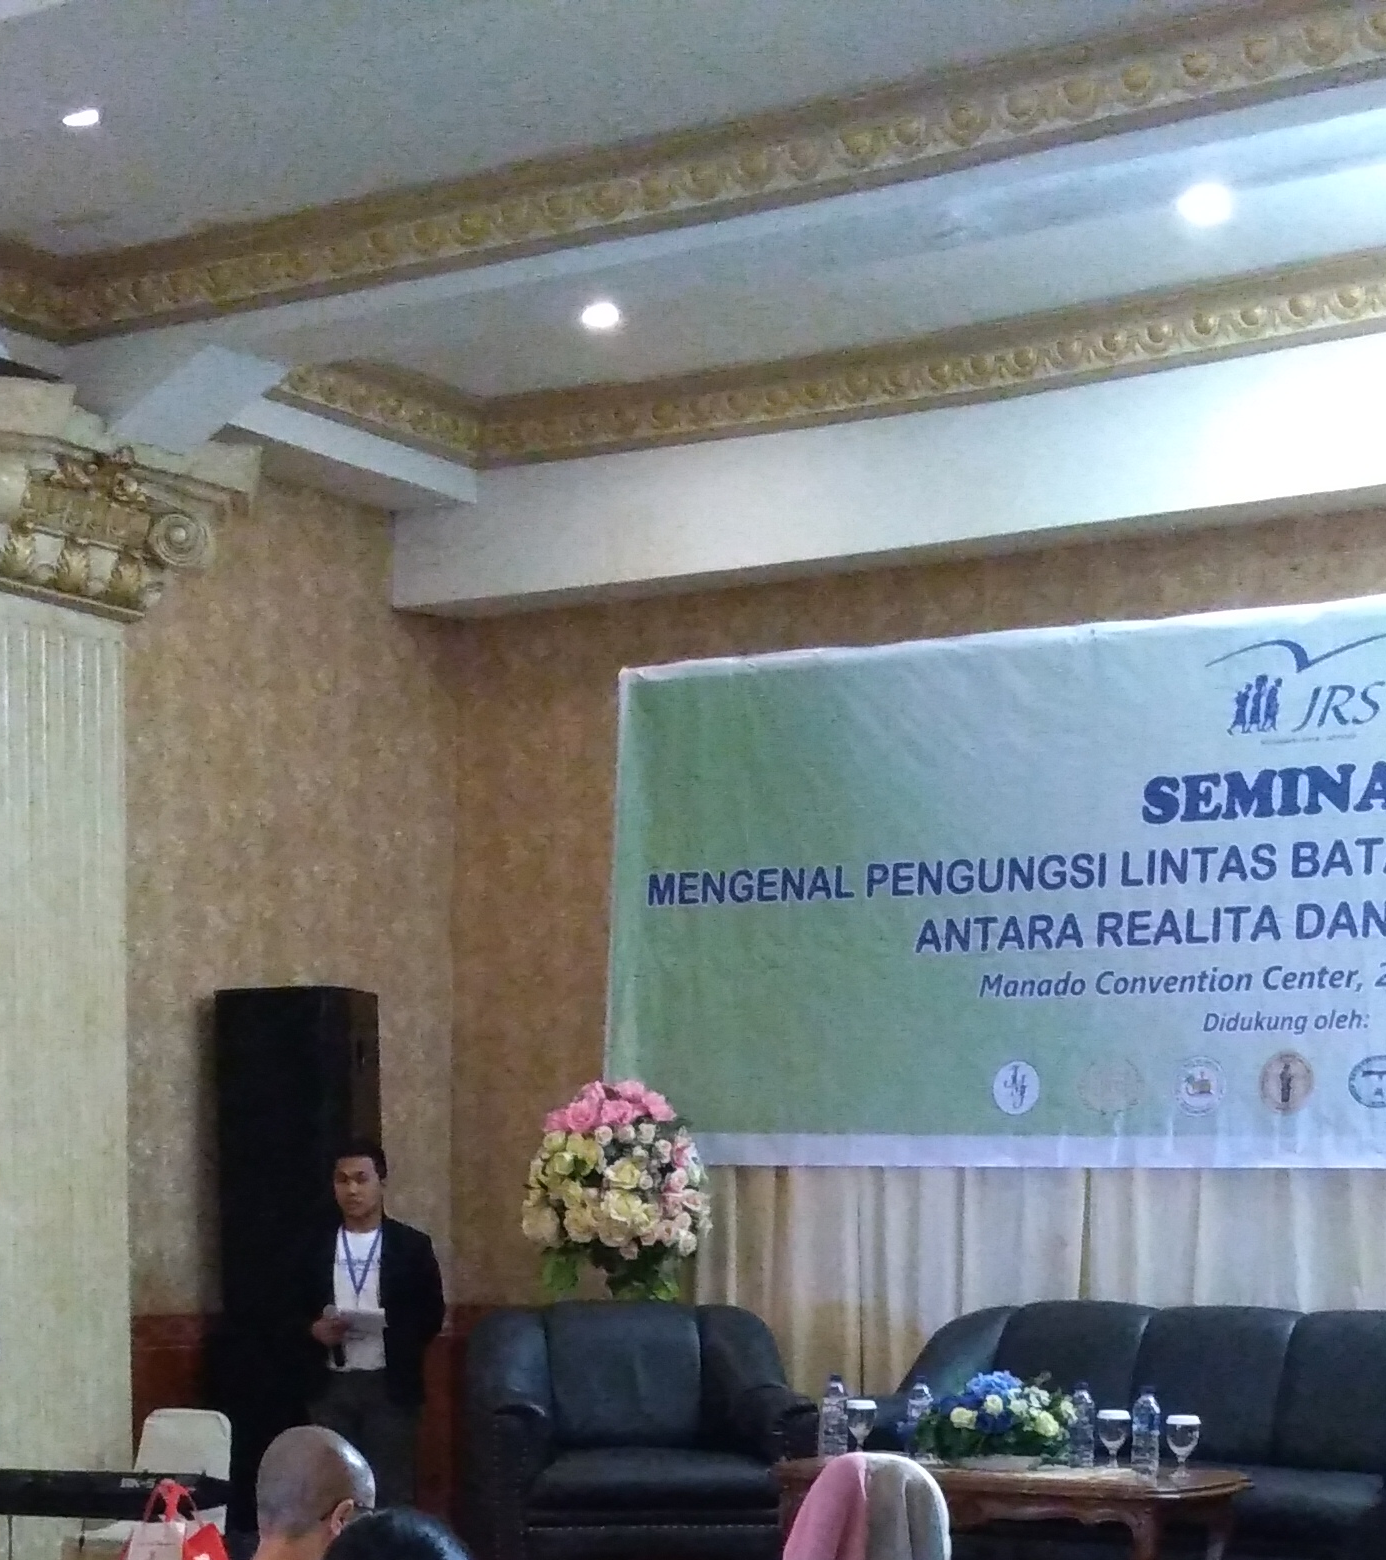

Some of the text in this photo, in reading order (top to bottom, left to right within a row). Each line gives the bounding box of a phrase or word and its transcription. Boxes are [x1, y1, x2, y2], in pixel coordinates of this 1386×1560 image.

[1291, 681, 1385, 733] JRS
[648, 865, 855, 906] MENGENAL
[866, 853, 1106, 898] PENGUNGSI
[1120, 843, 1277, 887] LINTAS
[915, 914, 1084, 953] ANTARA
[1096, 905, 1282, 948] REALITA
[979, 971, 1086, 998] Manado
[1095, 964, 1253, 996] Convention
[1262, 963, 1363, 993] Center,
[1203, 1009, 1370, 1035] Didukung oleh:
